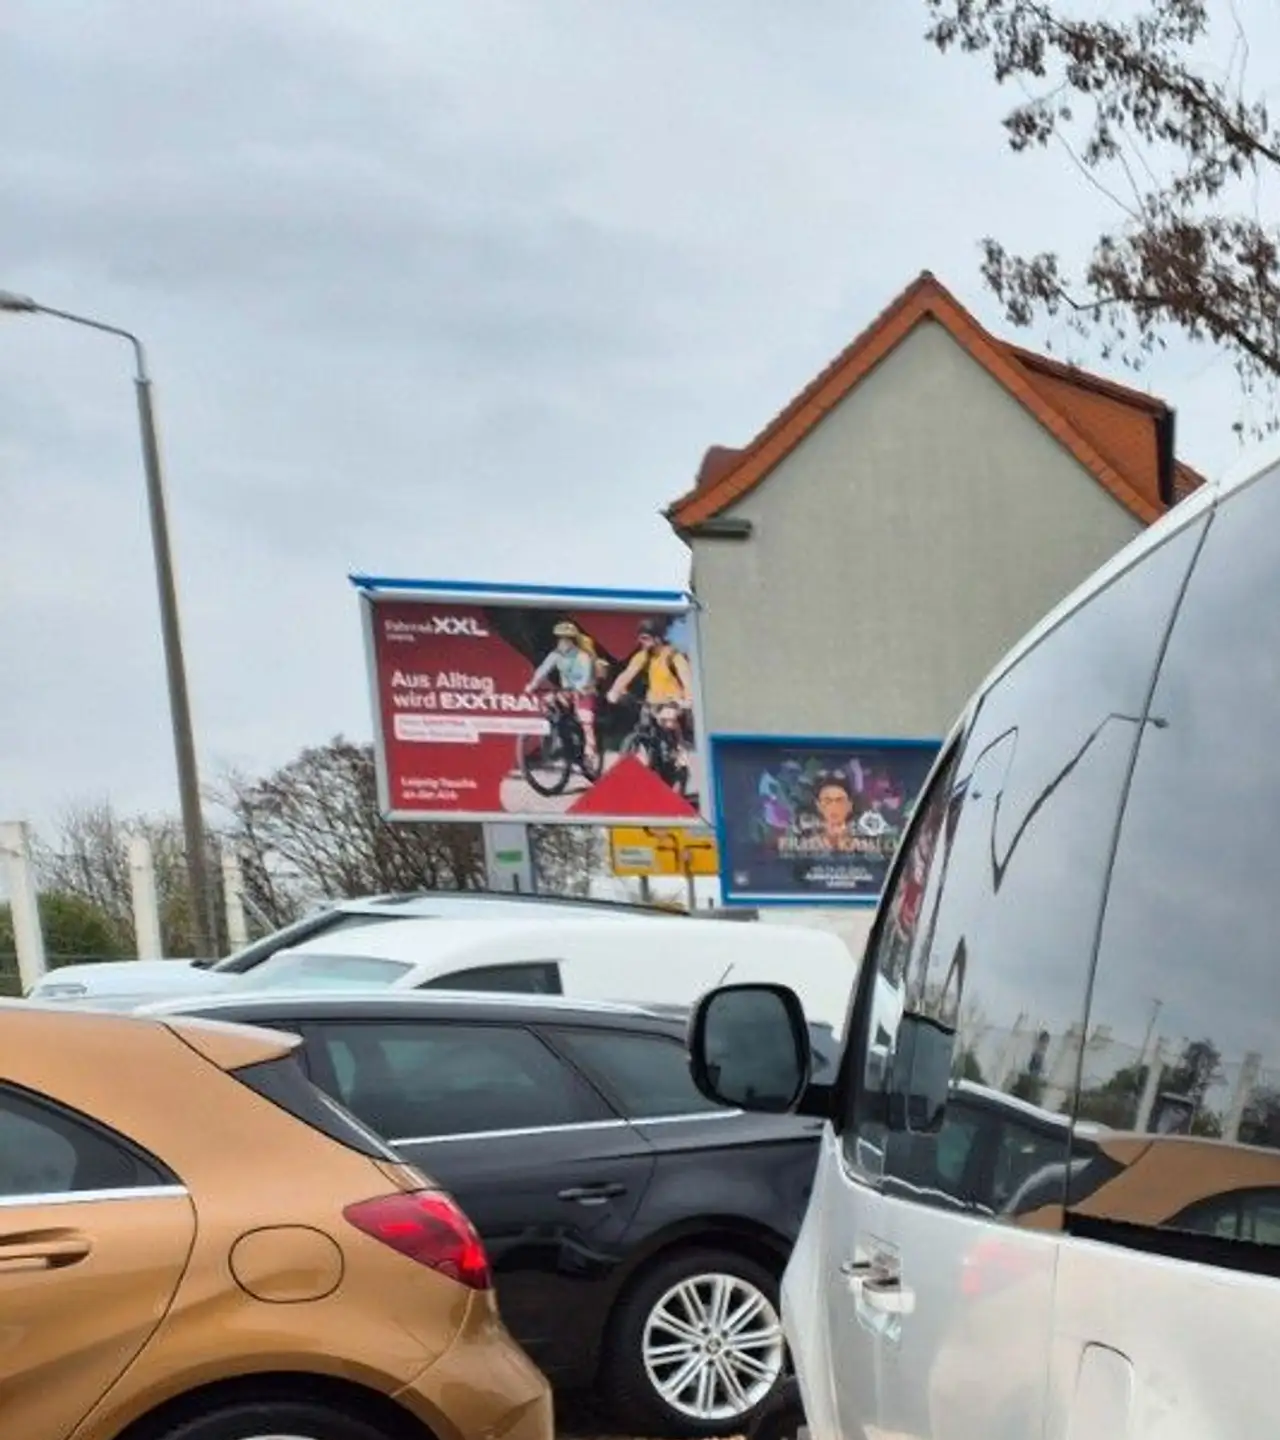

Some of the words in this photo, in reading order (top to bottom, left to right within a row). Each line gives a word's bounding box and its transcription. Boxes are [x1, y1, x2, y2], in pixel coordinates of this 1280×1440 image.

[391, 669, 430, 688] Aus
[436, 672, 494, 694] Alltag
[393, 690, 437, 709] wird
